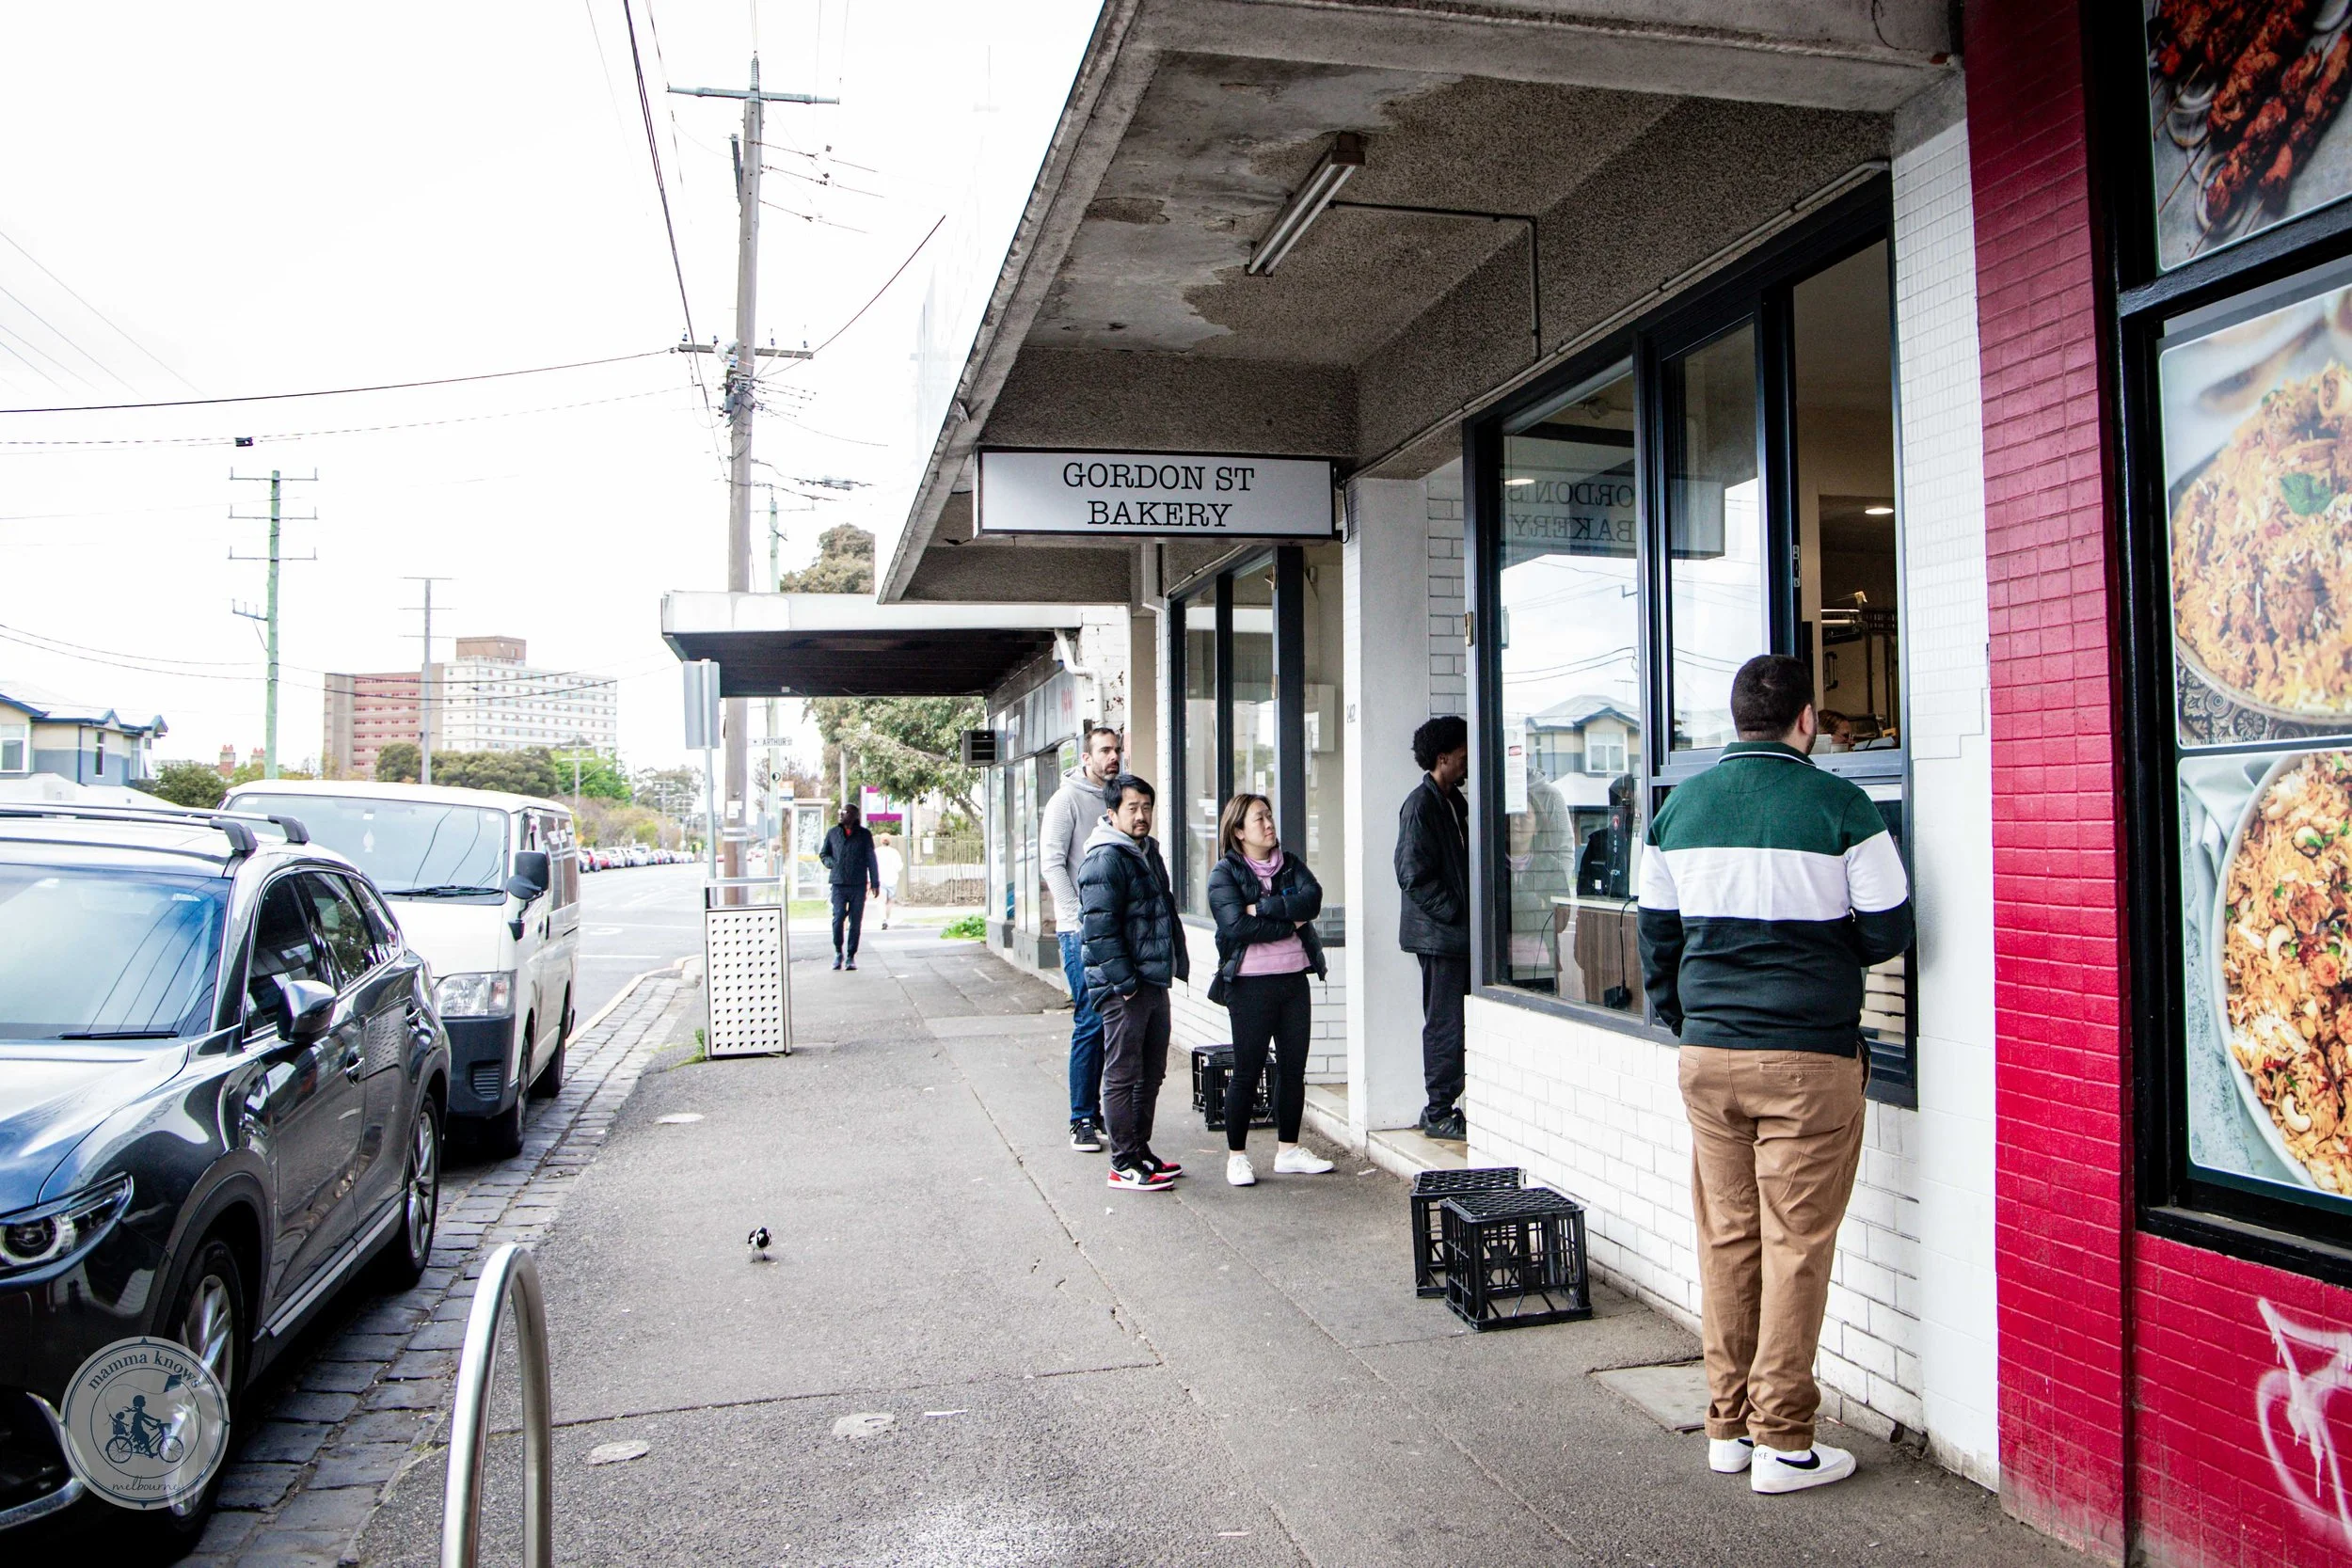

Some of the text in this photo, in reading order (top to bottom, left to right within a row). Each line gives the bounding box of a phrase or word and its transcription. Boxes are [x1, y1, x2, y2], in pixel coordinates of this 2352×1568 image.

[1063, 462, 1255, 491] GORDON ST
[1088, 500, 1232, 527] BAKERY
[763, 737, 787, 746] ARTHUR
